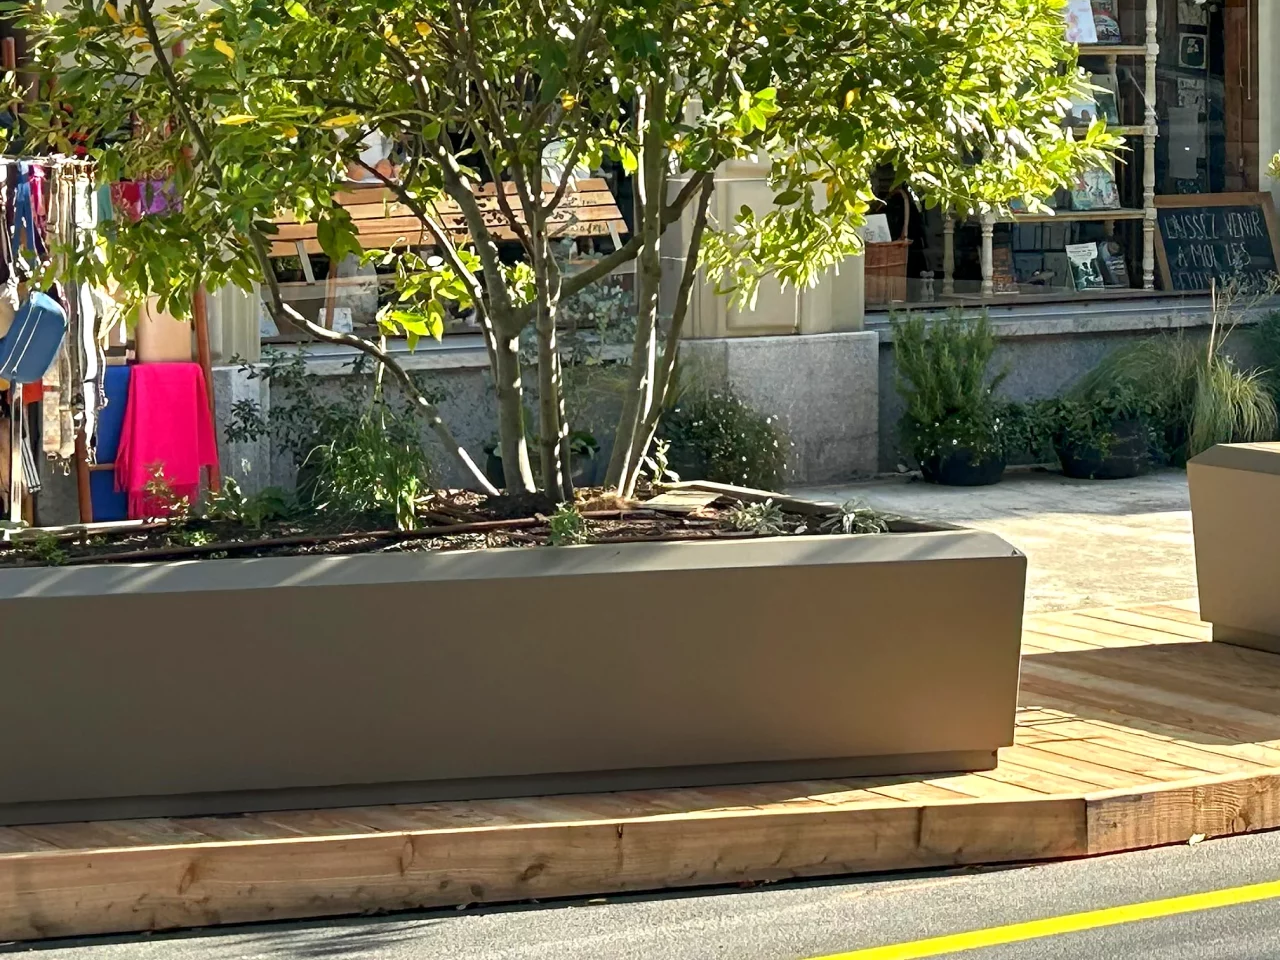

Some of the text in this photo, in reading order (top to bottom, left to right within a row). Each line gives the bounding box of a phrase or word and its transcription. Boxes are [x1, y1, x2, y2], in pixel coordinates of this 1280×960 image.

[1164, 211, 1263, 240] LAISSEZ VENIR
[1190, 243, 1217, 268] MOI
[1225, 241, 1252, 267] LES
